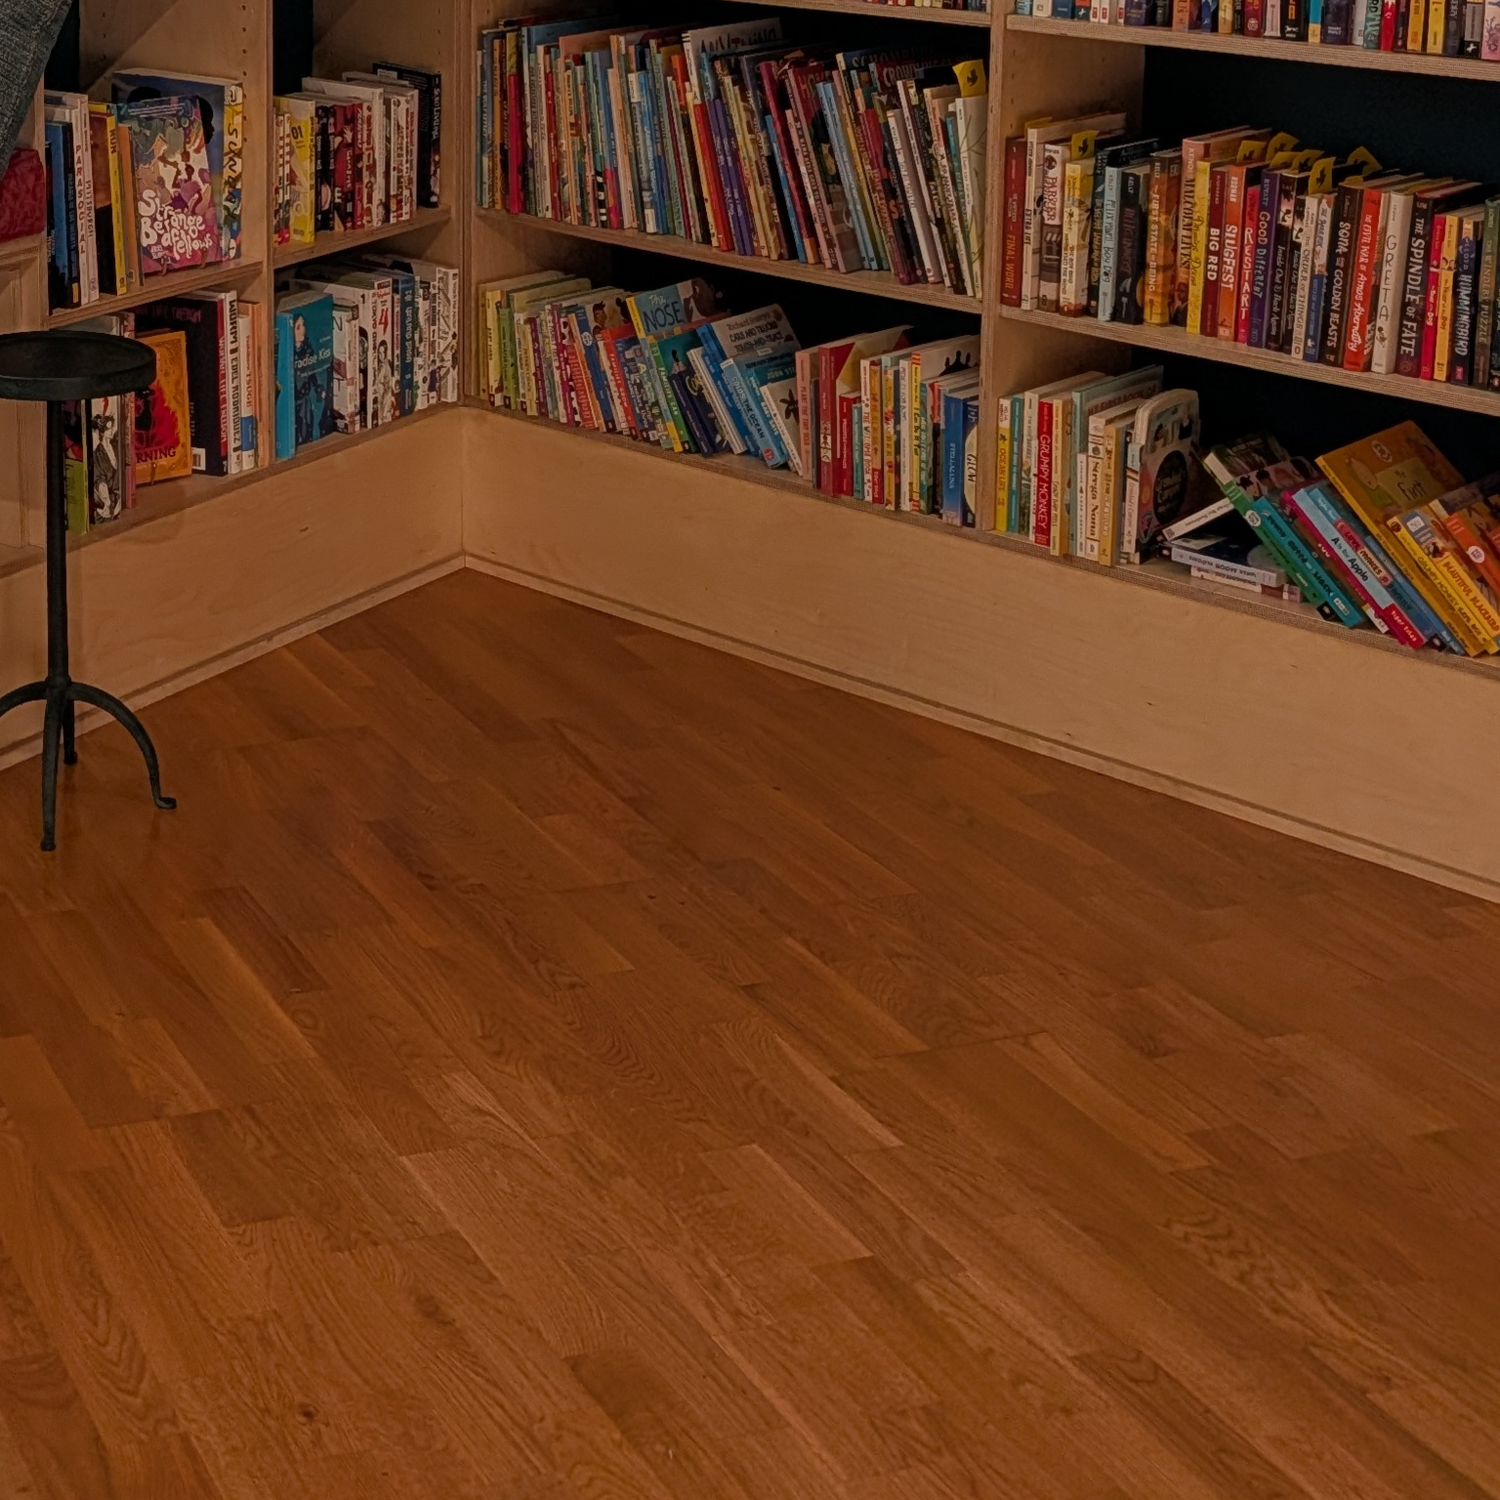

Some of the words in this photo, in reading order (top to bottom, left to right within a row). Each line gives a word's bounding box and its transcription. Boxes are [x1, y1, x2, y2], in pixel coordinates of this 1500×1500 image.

[75, 145, 86, 254] PARASOCIAL
[1209, 228, 1220, 250] BIG
[1414, 218, 1424, 235] THE
[1207, 253, 1218, 281] RED
[1221, 224, 1237, 290] SLUGFEST
[1240, 229, 1253, 319] RESTART
[1379, 235, 1397, 321] GRETA
[1406, 237, 1425, 304] SPINDLE
[1401, 319, 1417, 356] FATE
[1039, 434, 1050, 480] GRUMPY
[1037, 481, 1049, 530] MONKEY
